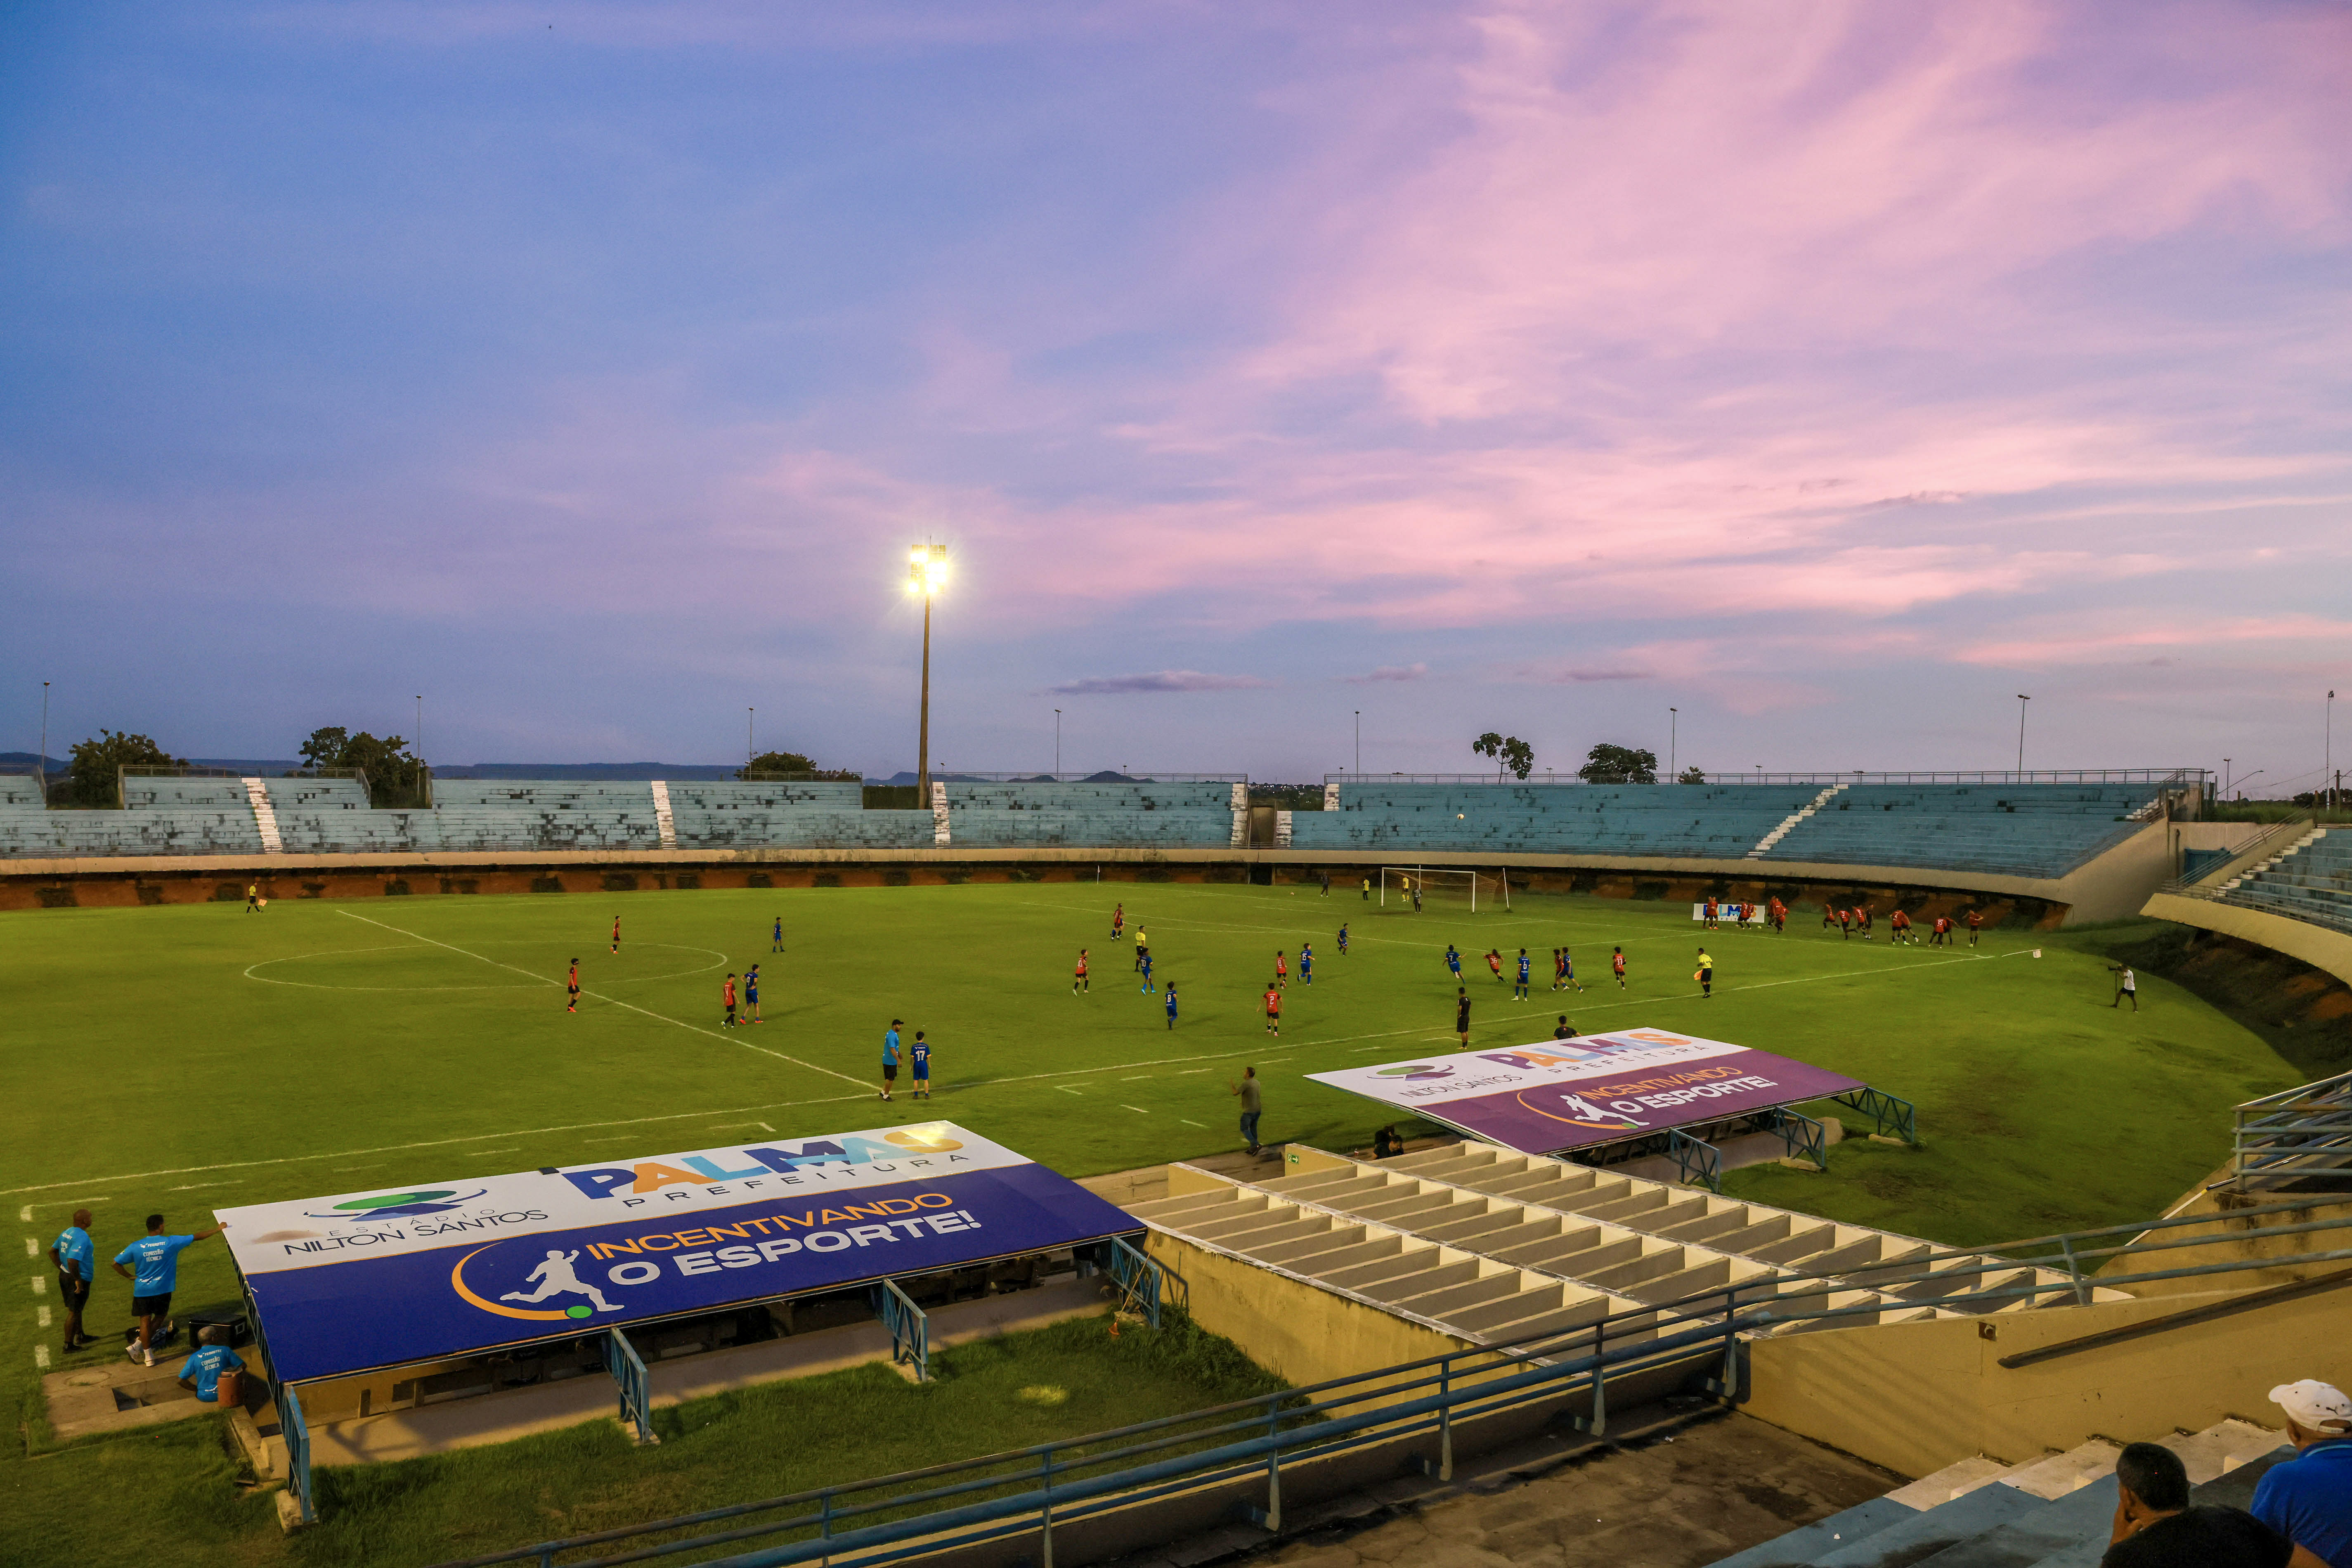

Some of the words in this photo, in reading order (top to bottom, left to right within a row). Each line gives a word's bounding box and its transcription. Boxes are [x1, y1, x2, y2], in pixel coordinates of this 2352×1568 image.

[1141, 959, 1146, 967] 10
[1302, 953, 1307, 961] 15
[1523, 961, 1527, 970] 6
[1167, 994, 1171, 1003] 8
[1270, 996, 1274, 1005] 2
[916, 1050, 925, 1061] 17
[1475, 1033, 1692, 1070] PALMAS
[1547, 1045, 1710, 1074] PREFEITURA
[1398, 1085, 1461, 1098] NILTON
[1455, 1074, 1522, 1088] SANTOS
[1575, 1067, 1743, 1100] INCENTIVANDO
[1610, 1100, 1644, 1113] O
[1634, 1076, 1778, 1109] ESPORTE!
[561, 1131, 964, 1199] PALMAS
[622, 1154, 970, 1208] PREFEITURA
[284, 1230, 405, 1255] NILTON
[414, 1210, 548, 1236] SANTOS
[329, 1209, 496, 1237] ESTÁDIO
[586, 1193, 953, 1260] INCENTIVANDO
[608, 1261, 660, 1285] O
[672, 1210, 982, 1276] ESPORTE!
[201, 1356, 220, 1366] COMISSÃO
[204, 1362, 220, 1371] TÉCNICA
